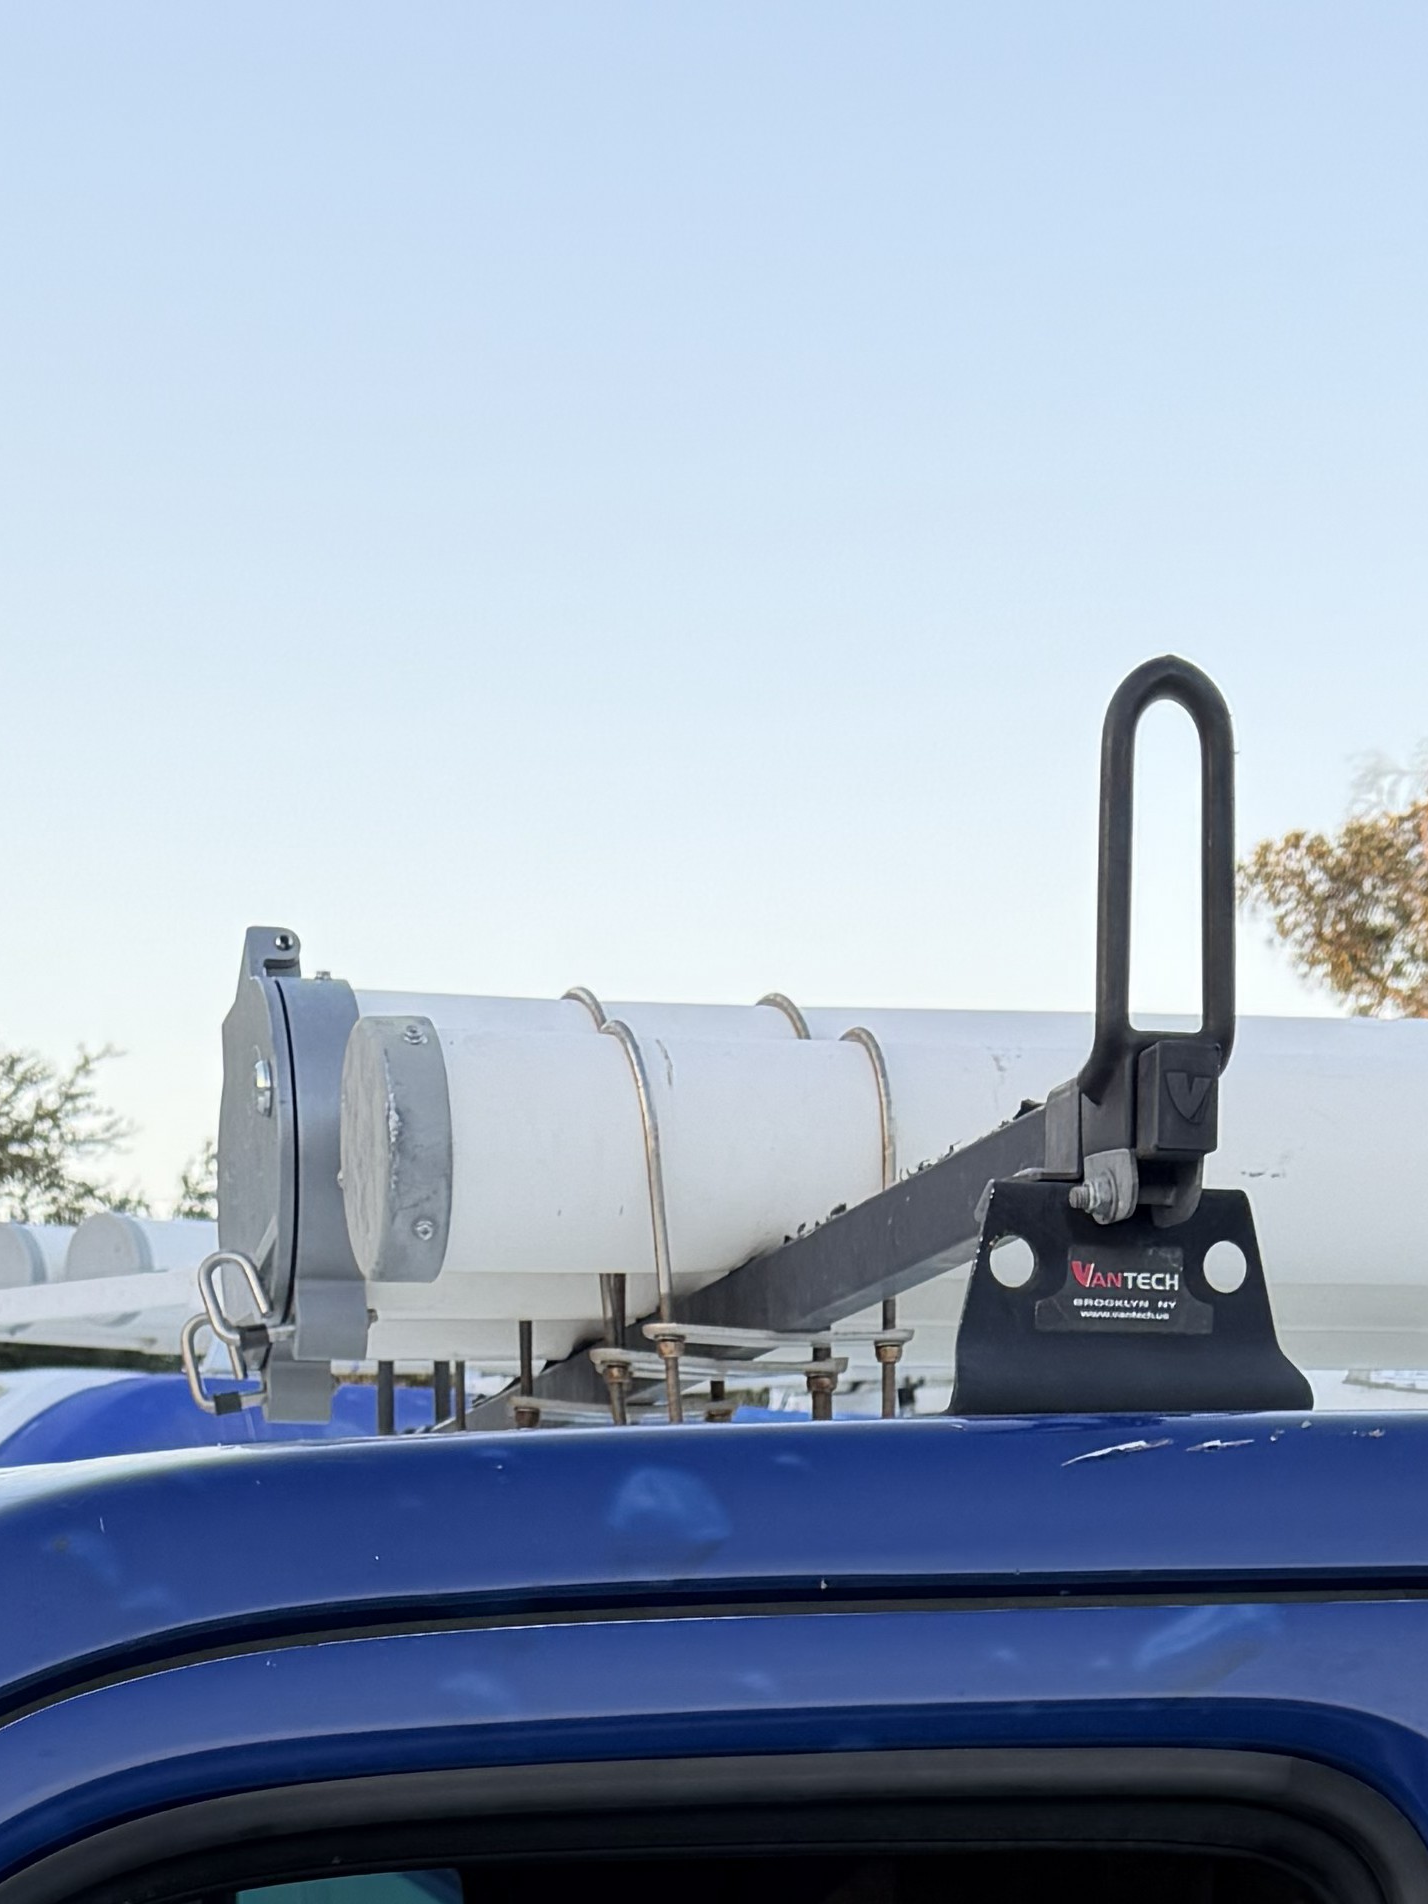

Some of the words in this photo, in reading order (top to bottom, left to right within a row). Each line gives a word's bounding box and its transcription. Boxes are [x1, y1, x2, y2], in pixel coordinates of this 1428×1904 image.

[1071, 1260, 1180, 1292] VANTECH
[1072, 1297, 1150, 1308] BROOKLYN
[1157, 1299, 1177, 1309] NY
